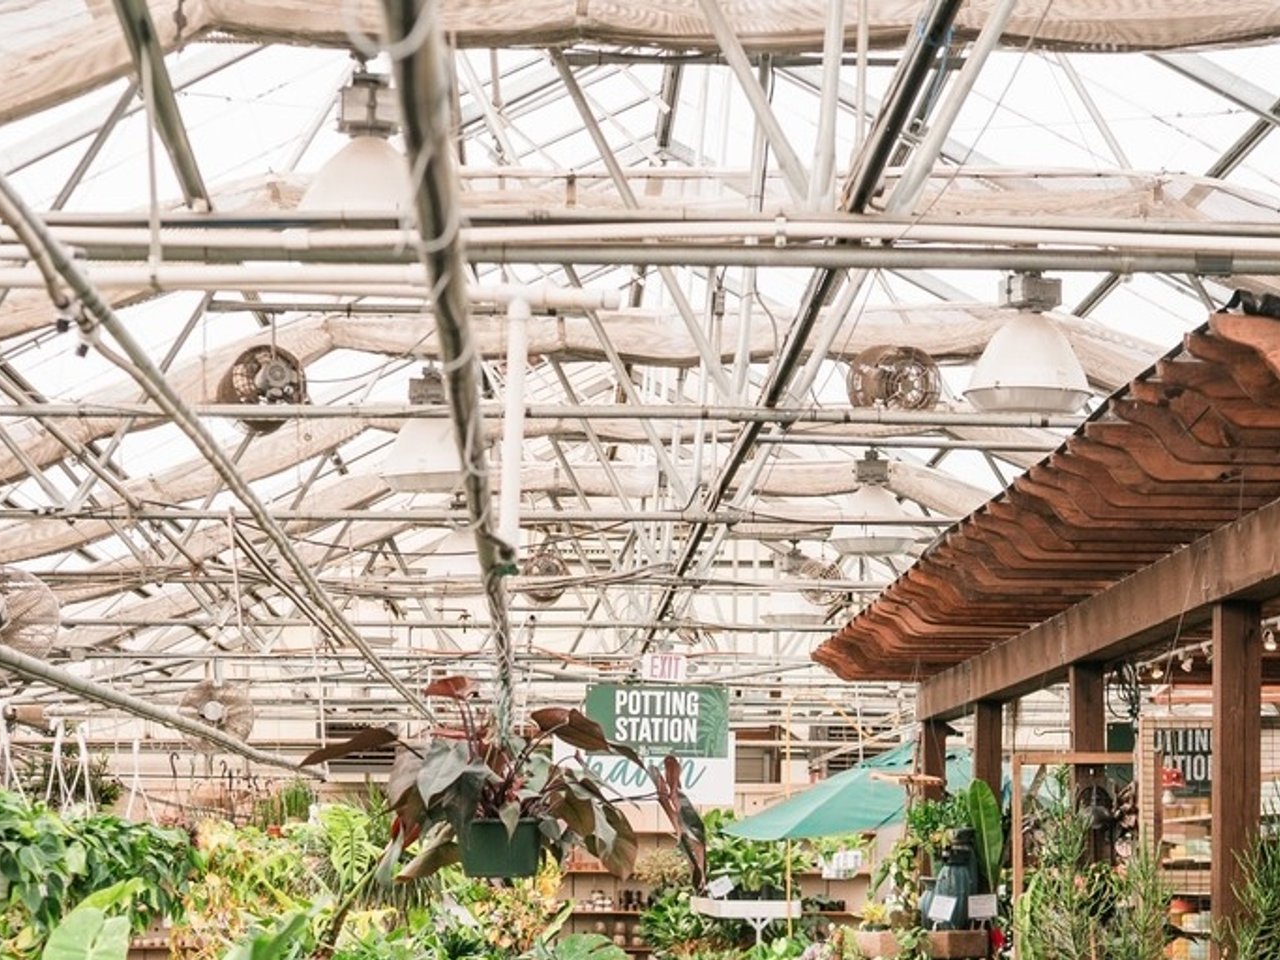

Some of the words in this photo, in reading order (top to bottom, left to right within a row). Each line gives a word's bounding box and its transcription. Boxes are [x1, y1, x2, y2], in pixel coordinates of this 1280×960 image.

[650, 655, 681, 679] EXIT
[615, 690, 699, 716] POTTING
[615, 717, 698, 743] STATION
